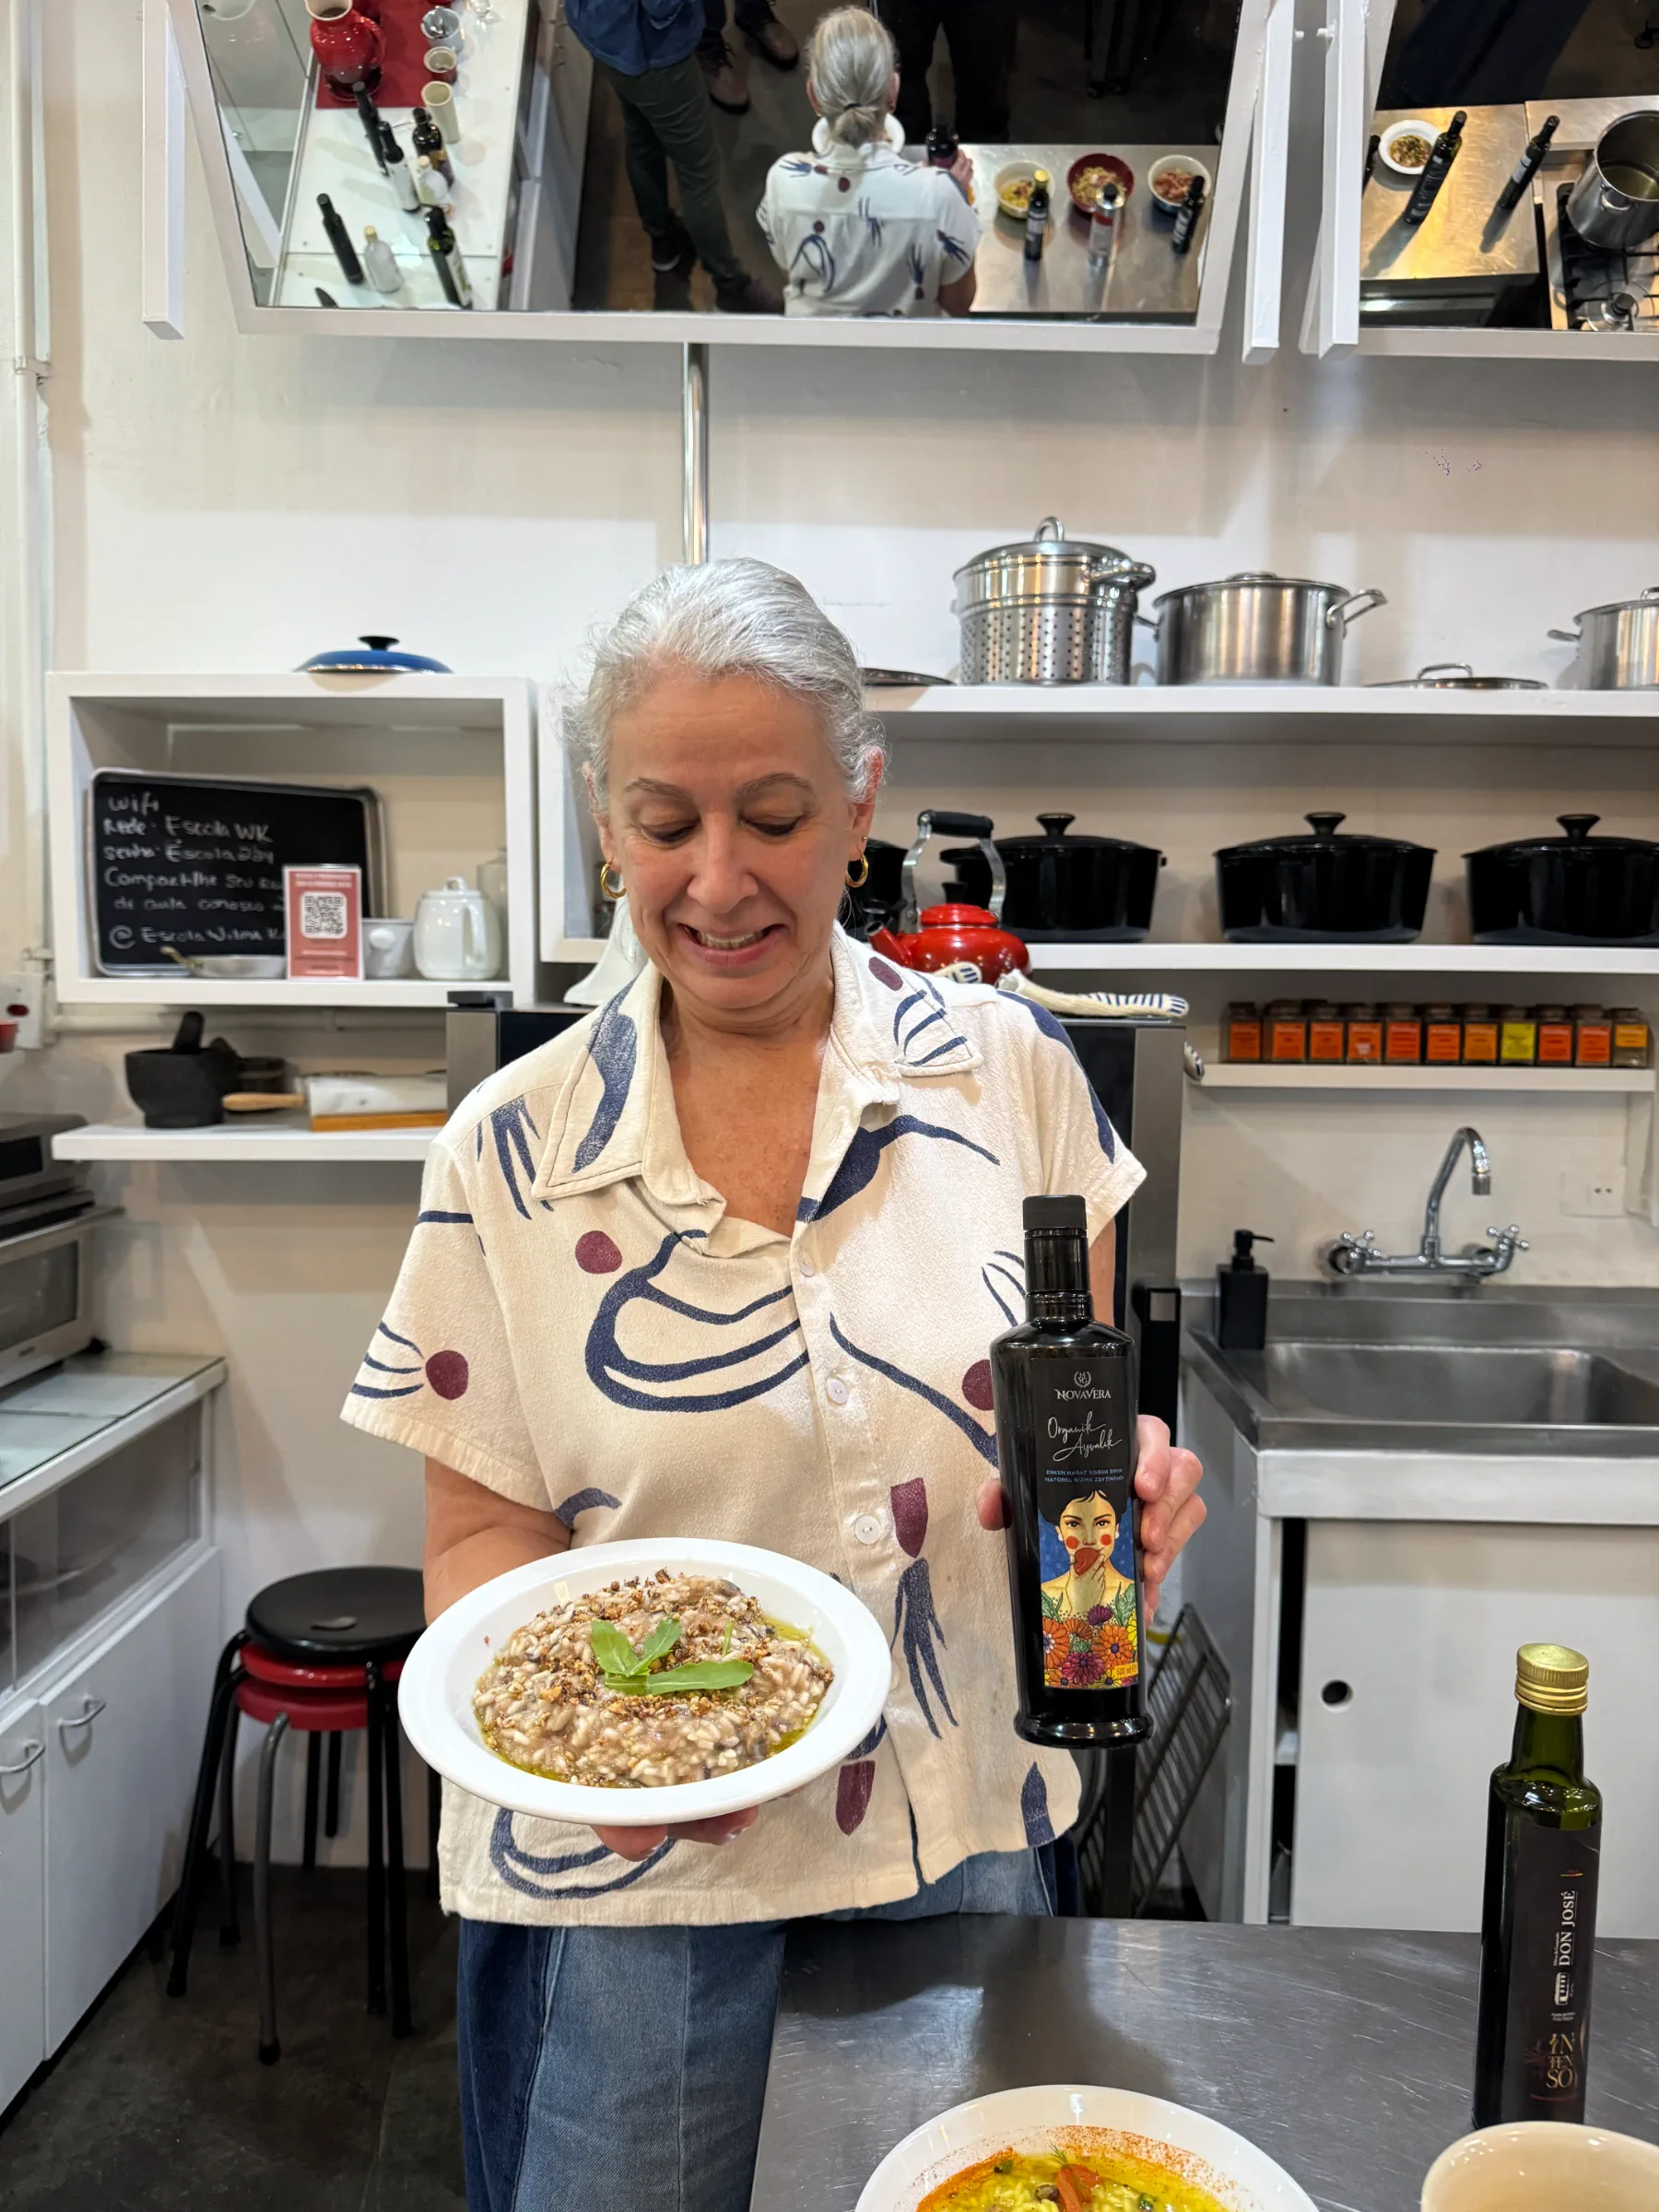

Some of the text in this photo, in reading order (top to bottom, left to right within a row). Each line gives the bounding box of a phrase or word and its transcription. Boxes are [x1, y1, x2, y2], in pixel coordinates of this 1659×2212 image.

[232, 821, 274, 843] WK
[140, 925, 206, 943] Escola
[206, 925, 263, 942] Vilma
[1048, 1410, 1106, 1443] Organik
[1560, 1890, 1576, 1927] JOSÉ
[1559, 1931, 1572, 1967] DON
[1546, 2067, 1573, 2088] SO
